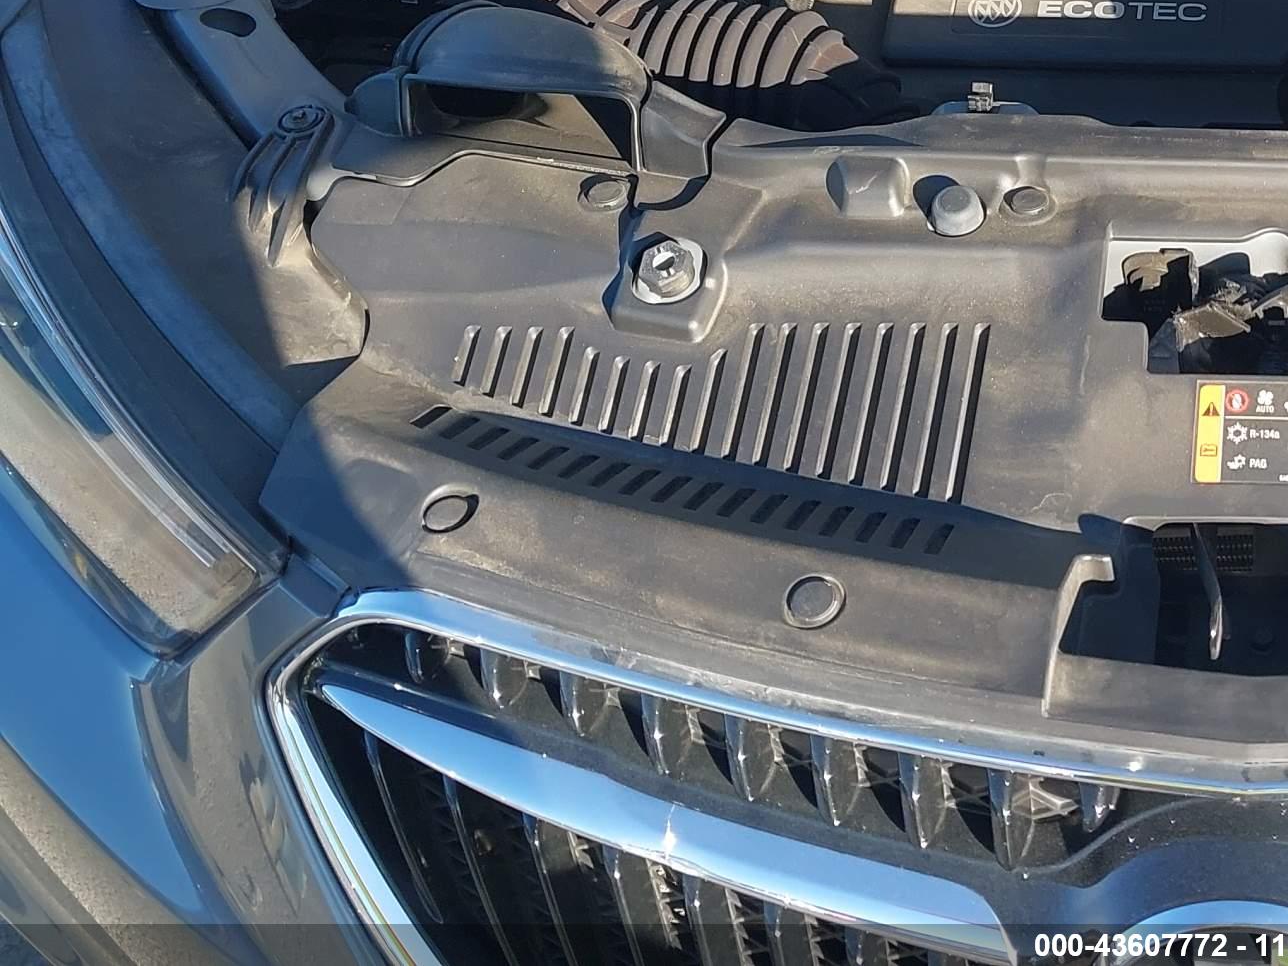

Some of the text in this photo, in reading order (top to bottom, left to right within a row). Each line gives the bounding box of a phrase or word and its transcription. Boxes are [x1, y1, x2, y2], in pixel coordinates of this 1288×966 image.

[1037, 0, 1208, 21] ECOTEC
[1255, 405, 1275, 414] AUTO
[1249, 428, 1281, 440] R-134a
[1249, 458, 1268, 470] PAG
